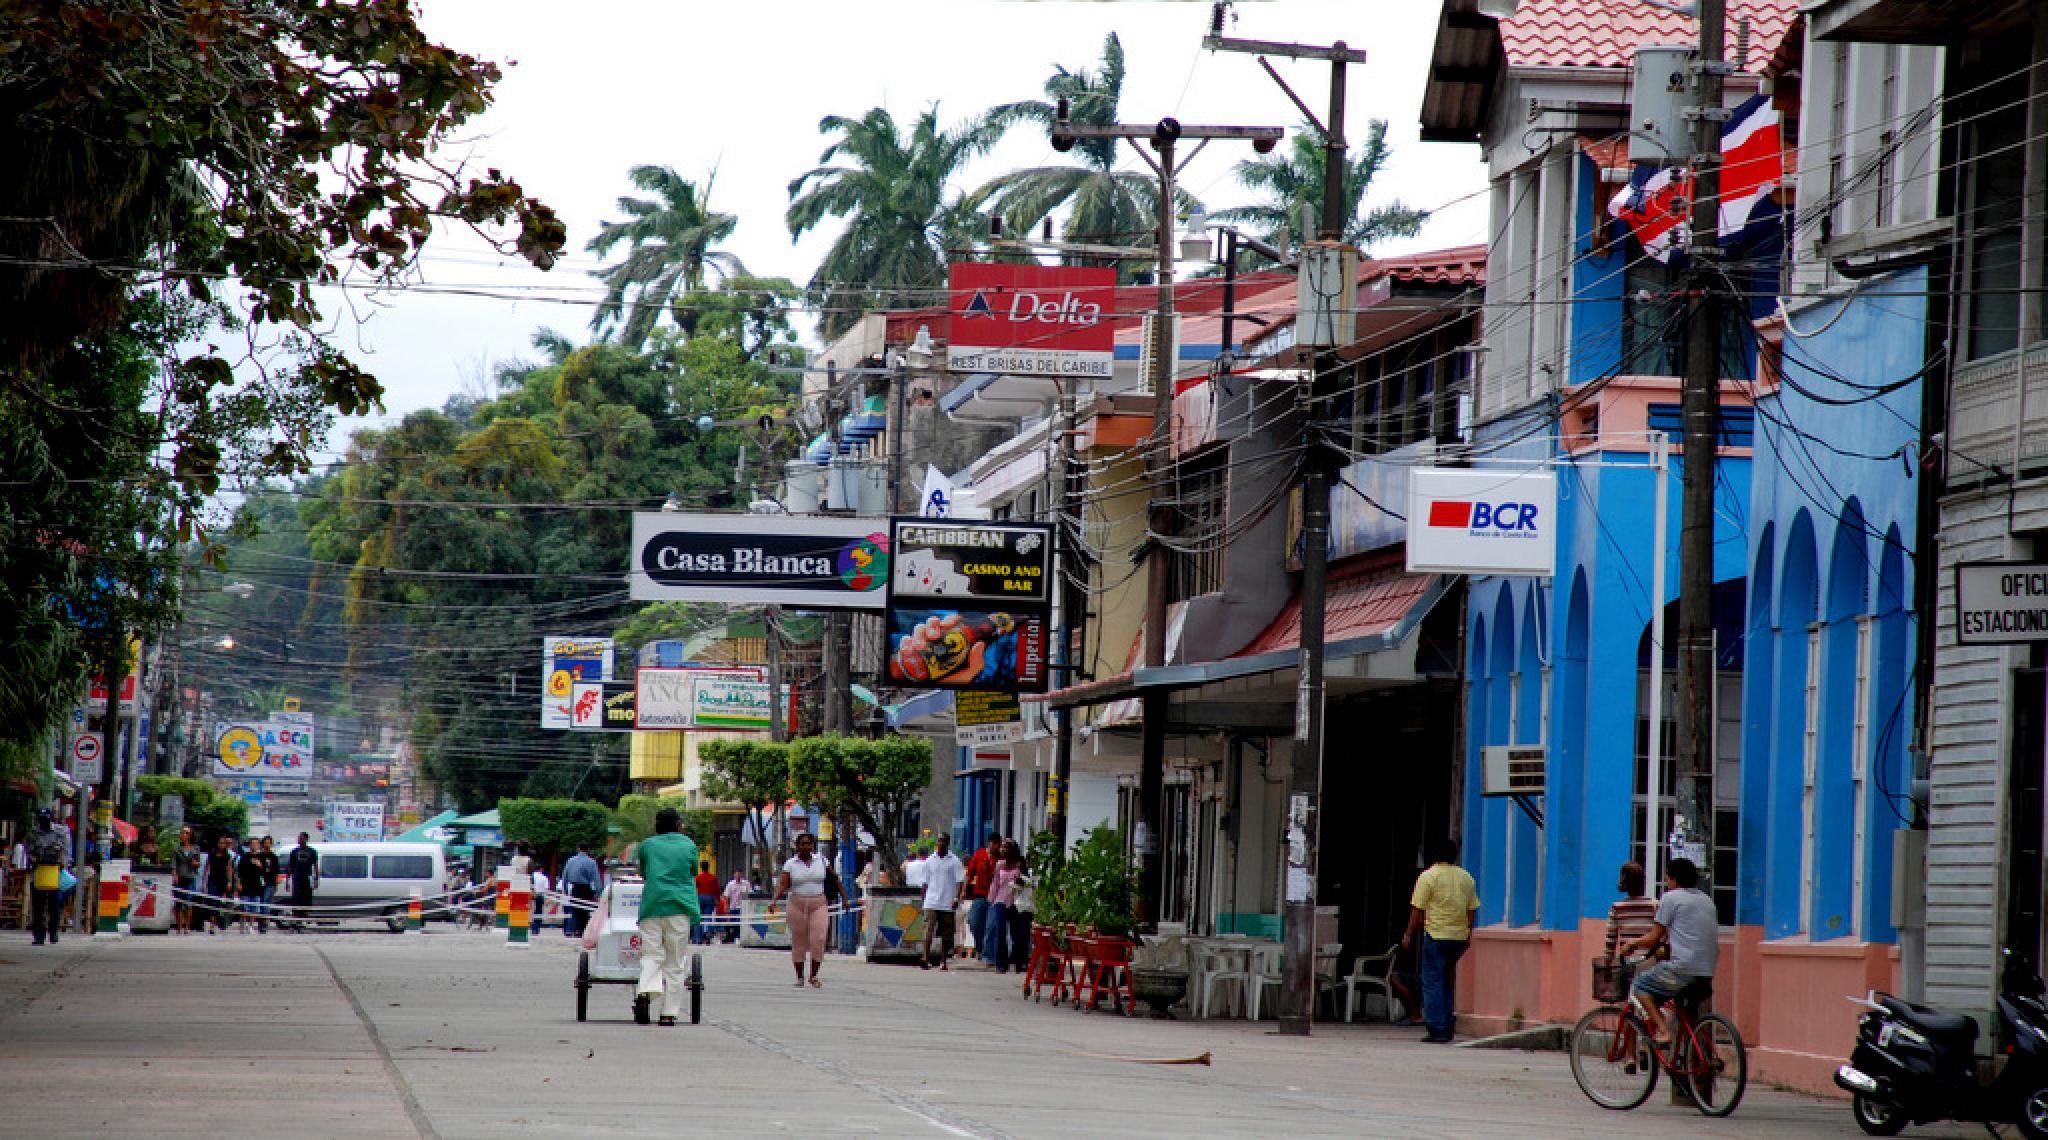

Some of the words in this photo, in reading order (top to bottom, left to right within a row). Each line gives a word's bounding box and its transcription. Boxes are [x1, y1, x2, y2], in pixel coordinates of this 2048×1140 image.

[1008, 291, 1101, 325] Delta
[987, 358, 1033, 372] BRISAS
[1037, 359, 1060, 373] DEL
[1063, 360, 1108, 376] CARIBE
[1471, 501, 1538, 530] BCR
[901, 527, 1005, 547] CARIBBEAN
[1470, 529, 1490, 537] Banco
[1523, 530, 1538, 538] Rica
[657, 545, 726, 571] Casa
[732, 547, 832, 575] Blanca
[963, 563, 1011, 575] CASINO
[1013, 565, 1041, 576] AND
[1003, 579, 1033, 591] BAR
[1017, 618, 1044, 683] Imperial
[257, 729, 277, 747] LA
